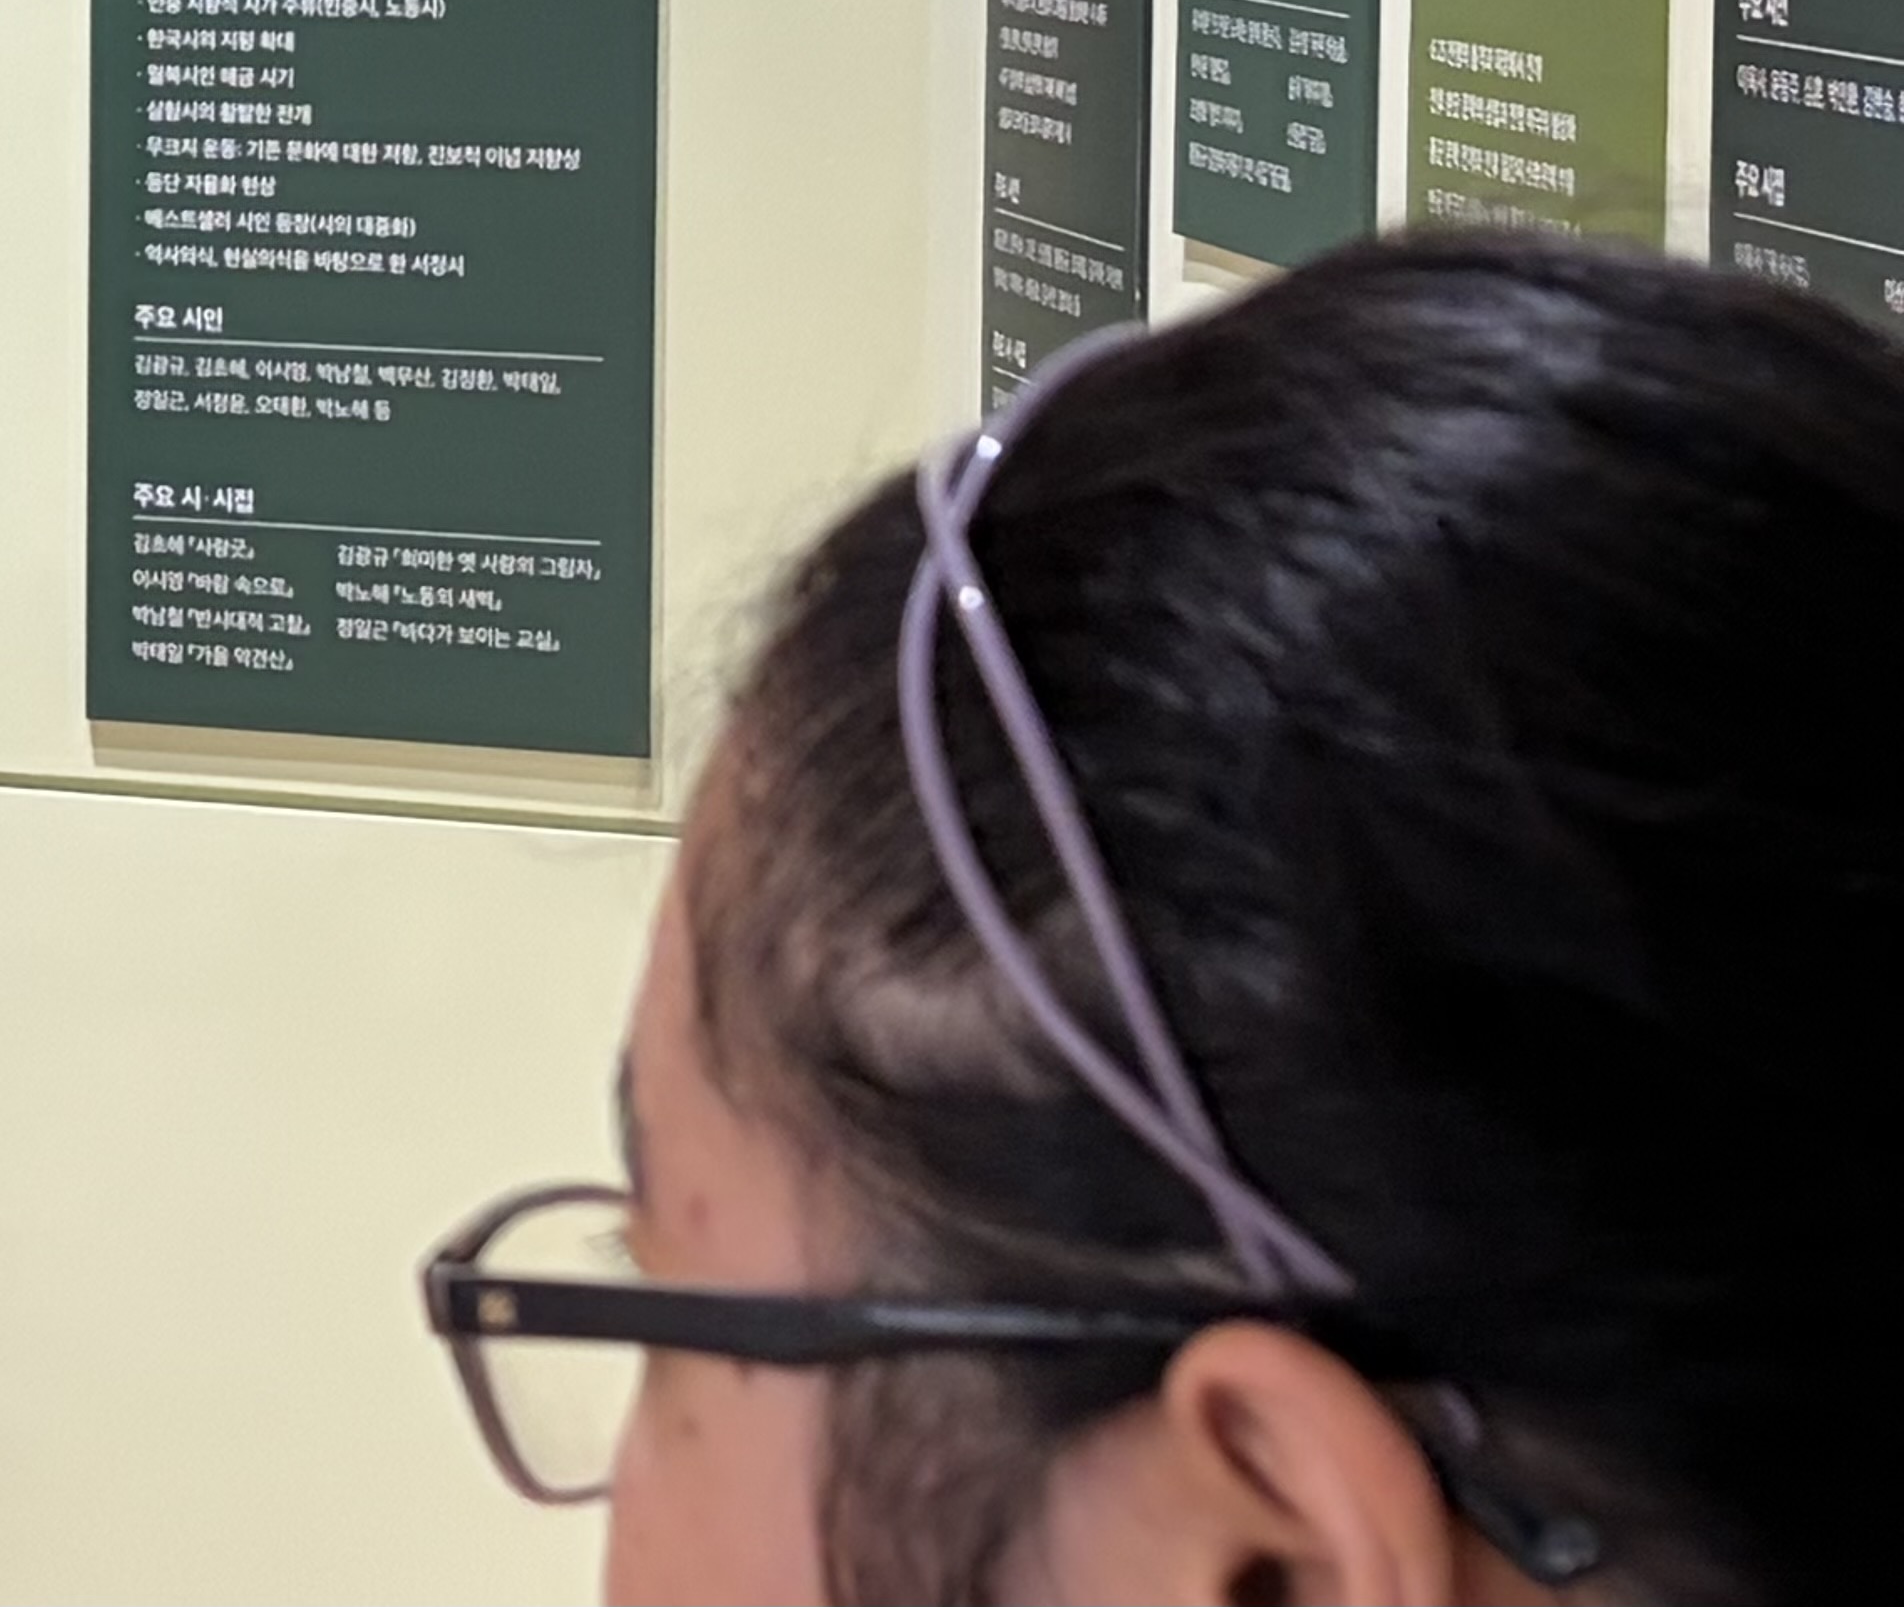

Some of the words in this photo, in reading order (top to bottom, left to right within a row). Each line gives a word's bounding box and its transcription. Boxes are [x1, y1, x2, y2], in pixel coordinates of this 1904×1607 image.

[134, 304, 177, 330] 주요
[182, 305, 223, 333] 시인
[133, 482, 175, 508] 주요
